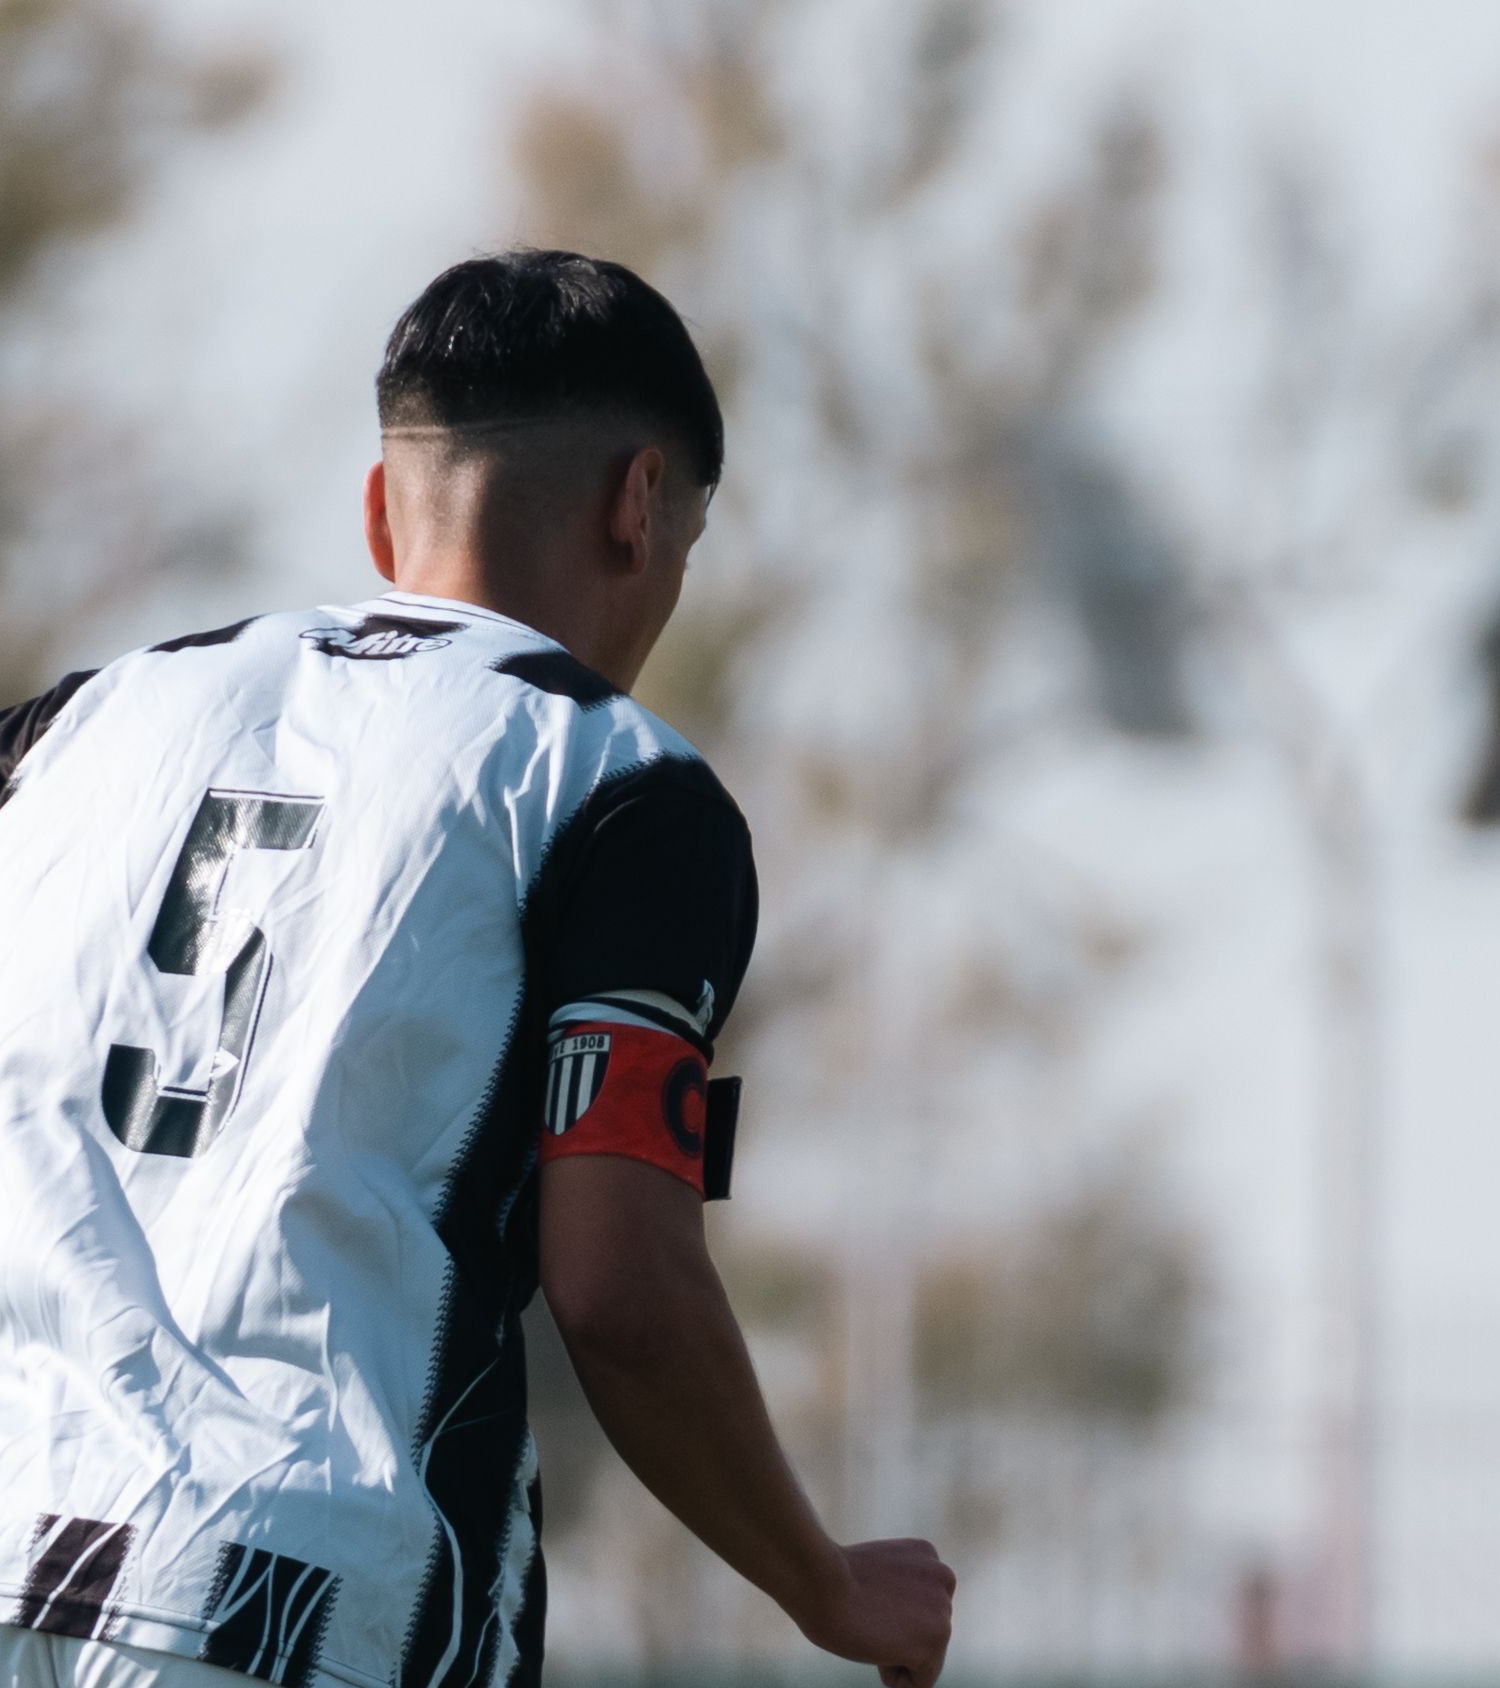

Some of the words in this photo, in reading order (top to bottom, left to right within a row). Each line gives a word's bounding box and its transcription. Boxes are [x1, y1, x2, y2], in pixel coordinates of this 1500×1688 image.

[102, 788, 325, 1159] 5
[572, 1035, 605, 1051] 1908
[664, 1058, 707, 1157] C
